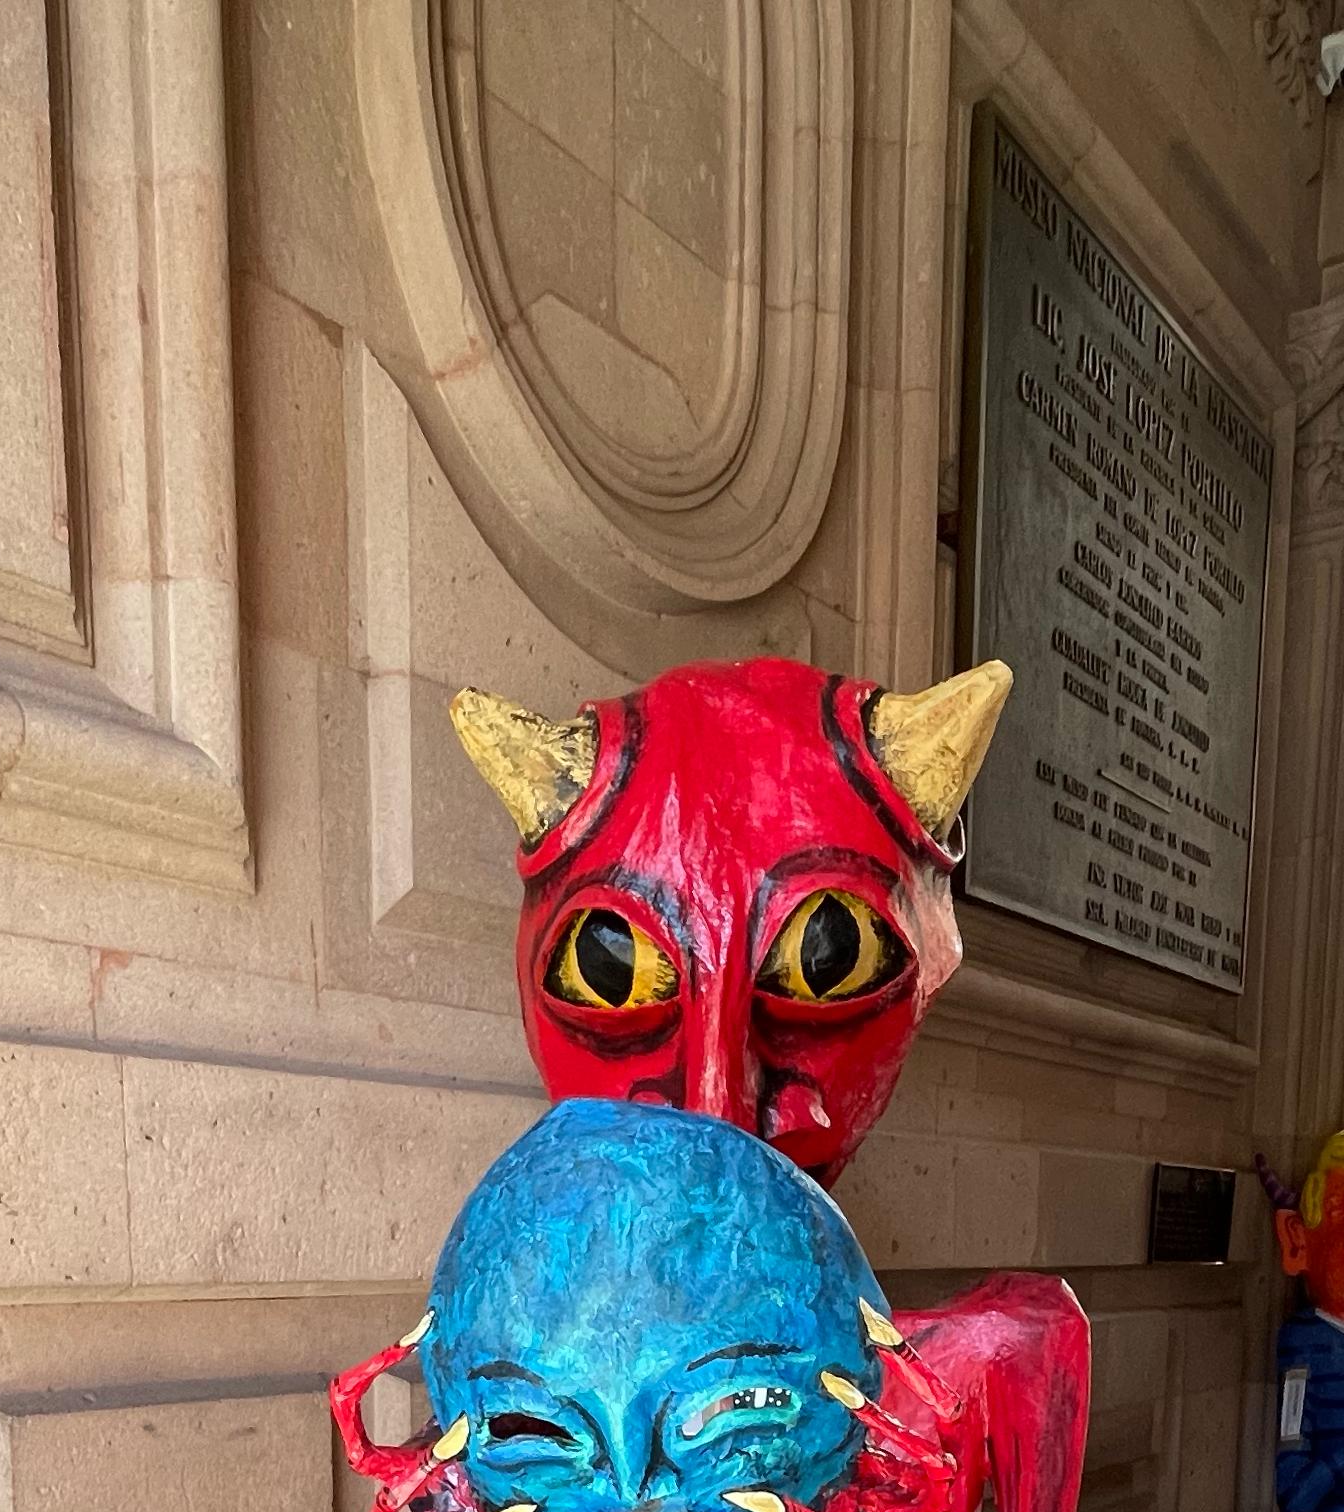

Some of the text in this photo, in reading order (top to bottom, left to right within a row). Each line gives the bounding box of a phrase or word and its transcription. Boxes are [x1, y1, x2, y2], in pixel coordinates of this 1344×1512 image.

[993, 129, 1057, 249] MUSEO
[1066, 215, 1147, 350] NACIONAL
[1154, 319, 1174, 380] DE
[1181, 350, 1199, 408] LA
[1018, 363, 1077, 454] CARMEN
[1086, 428, 1137, 508] ROMANO
[1143, 483, 1159, 528] DE
[1031, 278, 1066, 358] LIC.
[1076, 326, 1117, 410] JOSE
[1124, 378, 1175, 469] LOPEZ
[1181, 438, 1245, 539] PORTILLO
